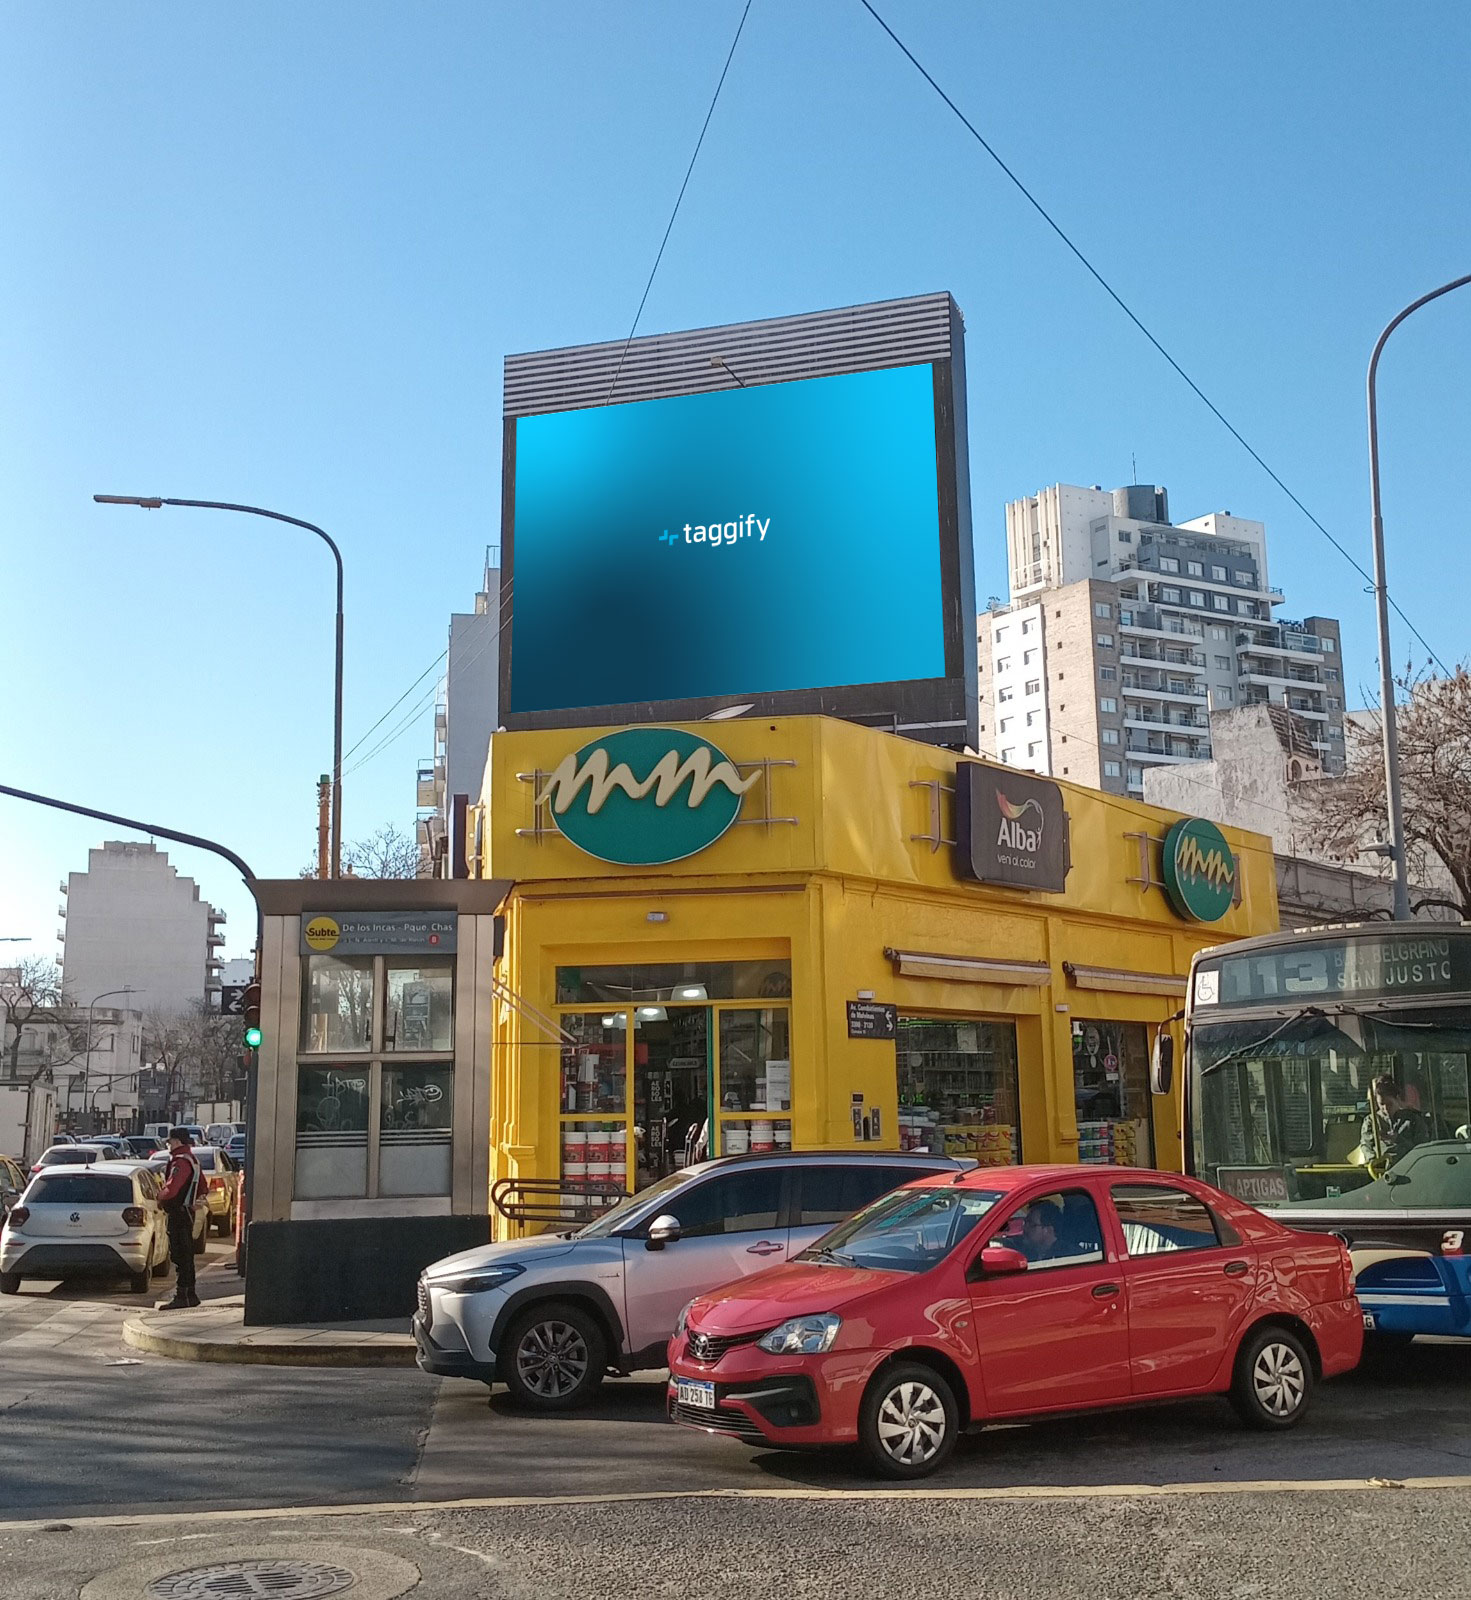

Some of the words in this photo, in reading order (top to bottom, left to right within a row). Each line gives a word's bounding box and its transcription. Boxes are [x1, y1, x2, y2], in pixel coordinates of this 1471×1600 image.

[682, 513, 771, 547] taggify
[997, 817, 1037, 852] Alba
[1019, 858, 1037, 869] color
[305, 927, 340, 937] Subte
[342, 923, 355, 932] De
[357, 923, 371, 932] los
[373, 923, 396, 932] Incas
[431, 922, 453, 931] Chas
[1373, 938, 1450, 964] BELGRANO
[1224, 951, 1329, 997] 113
[1337, 968, 1377, 990] SAN
[1441, 1230, 1464, 1251] 3
